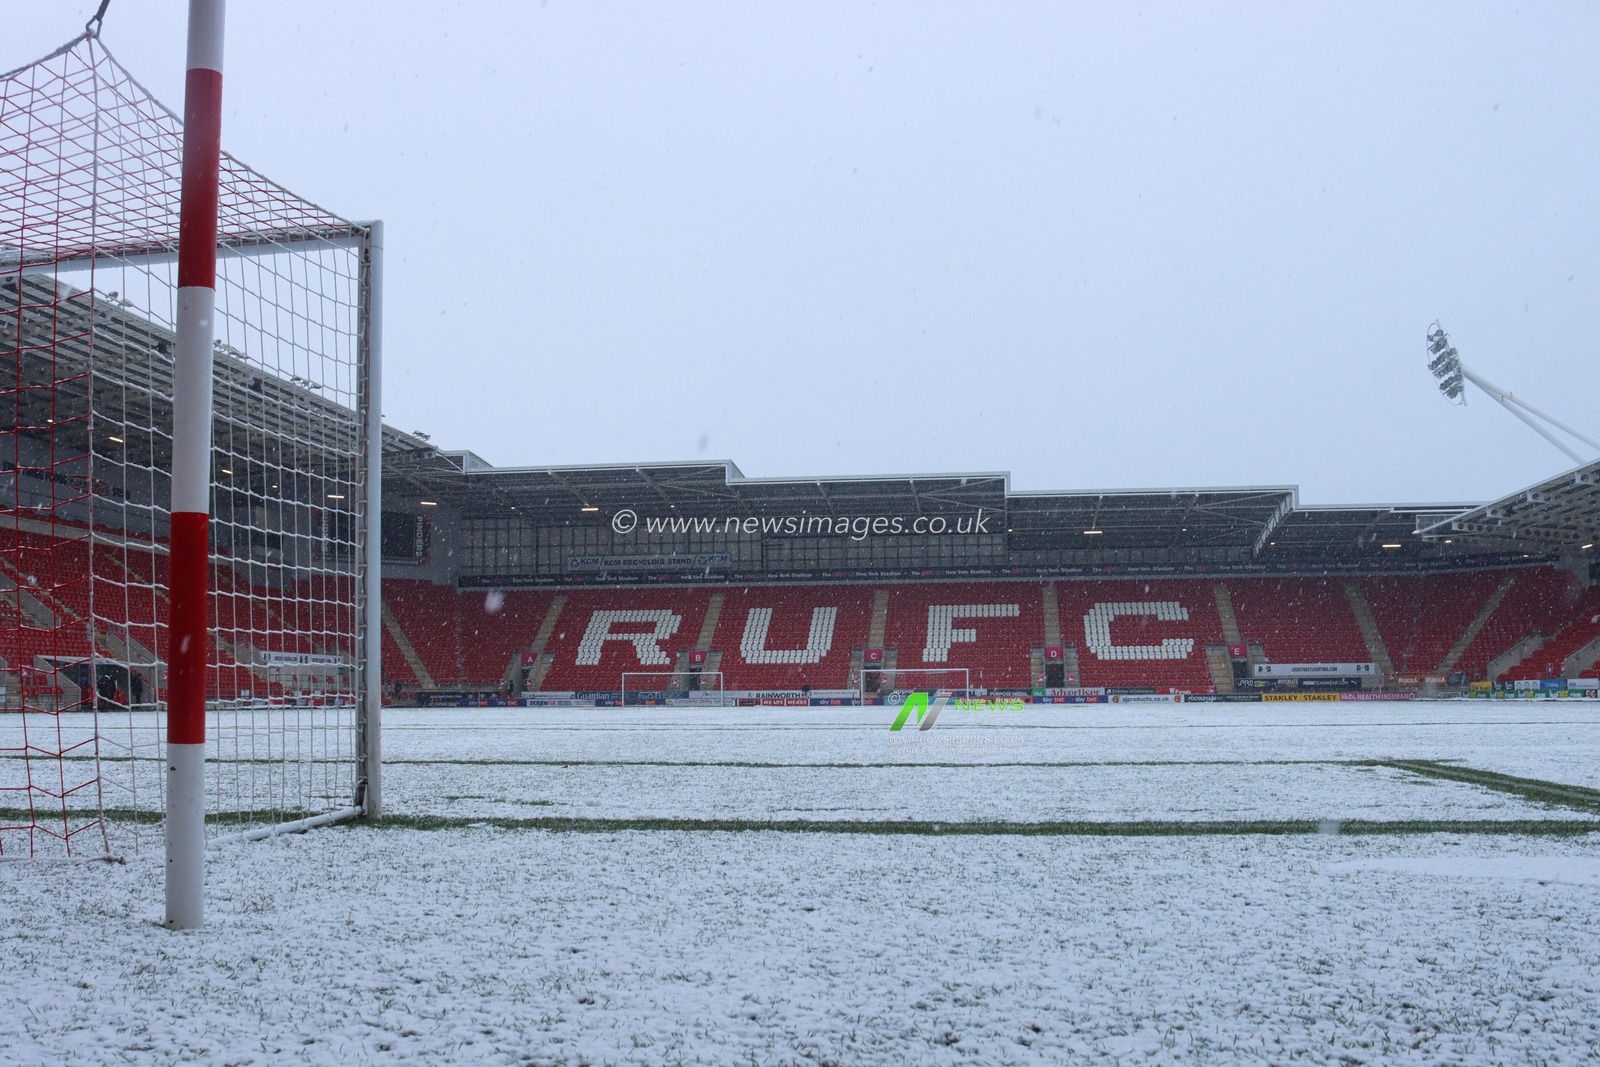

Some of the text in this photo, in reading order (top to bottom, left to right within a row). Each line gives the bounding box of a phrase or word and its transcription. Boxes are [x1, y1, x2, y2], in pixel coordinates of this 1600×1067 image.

[416, 516, 424, 557] PINDERS
[580, 558, 599, 566] KCM
[695, 654, 701, 662] B
[870, 652, 877, 660] C
[1050, 650, 1057, 658] D
[1381, 692, 1416, 700] INSURANCE
